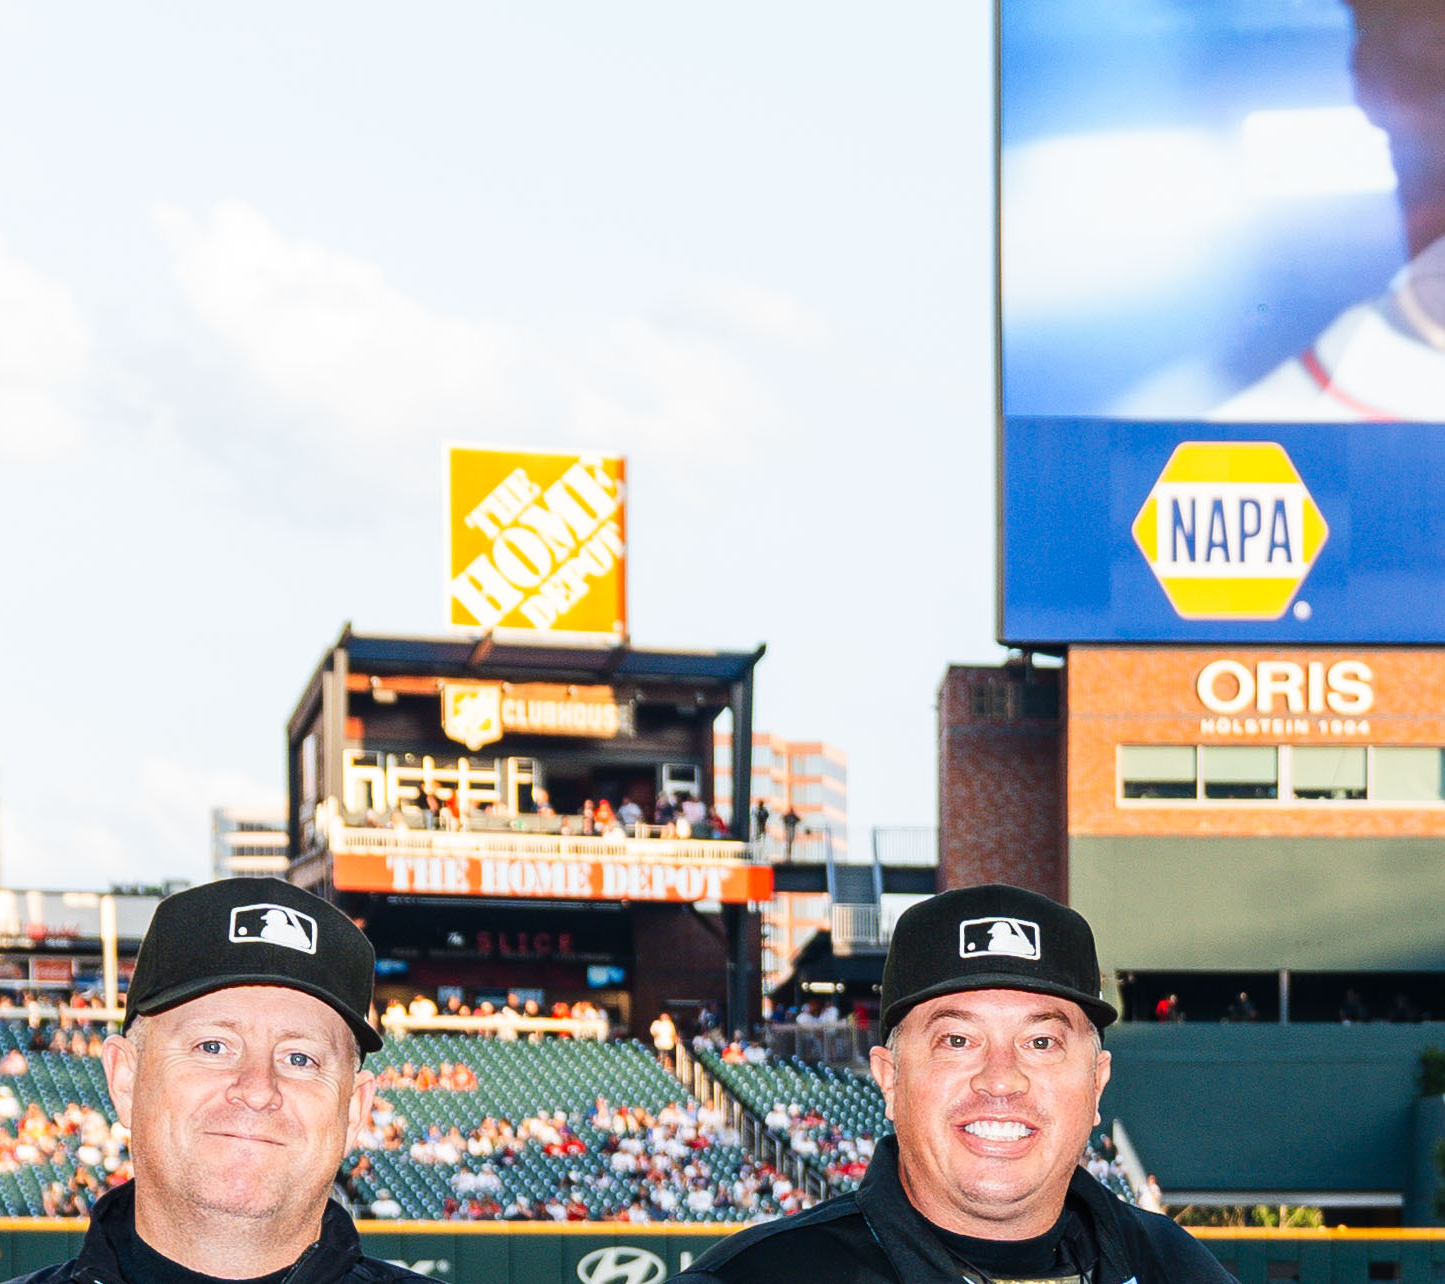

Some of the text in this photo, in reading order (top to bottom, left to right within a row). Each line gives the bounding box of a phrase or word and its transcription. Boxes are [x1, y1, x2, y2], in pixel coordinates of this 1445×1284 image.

[464, 466, 543, 540] THE
[1168, 496, 1295, 565] NAPA
[449, 456, 628, 625] HOME
[517, 519, 628, 629] DEPOT
[1196, 659, 1375, 715] ORIS
[386, 857, 729, 900] THE HOME DEPOT
[475, 931, 575, 953] SLICE
